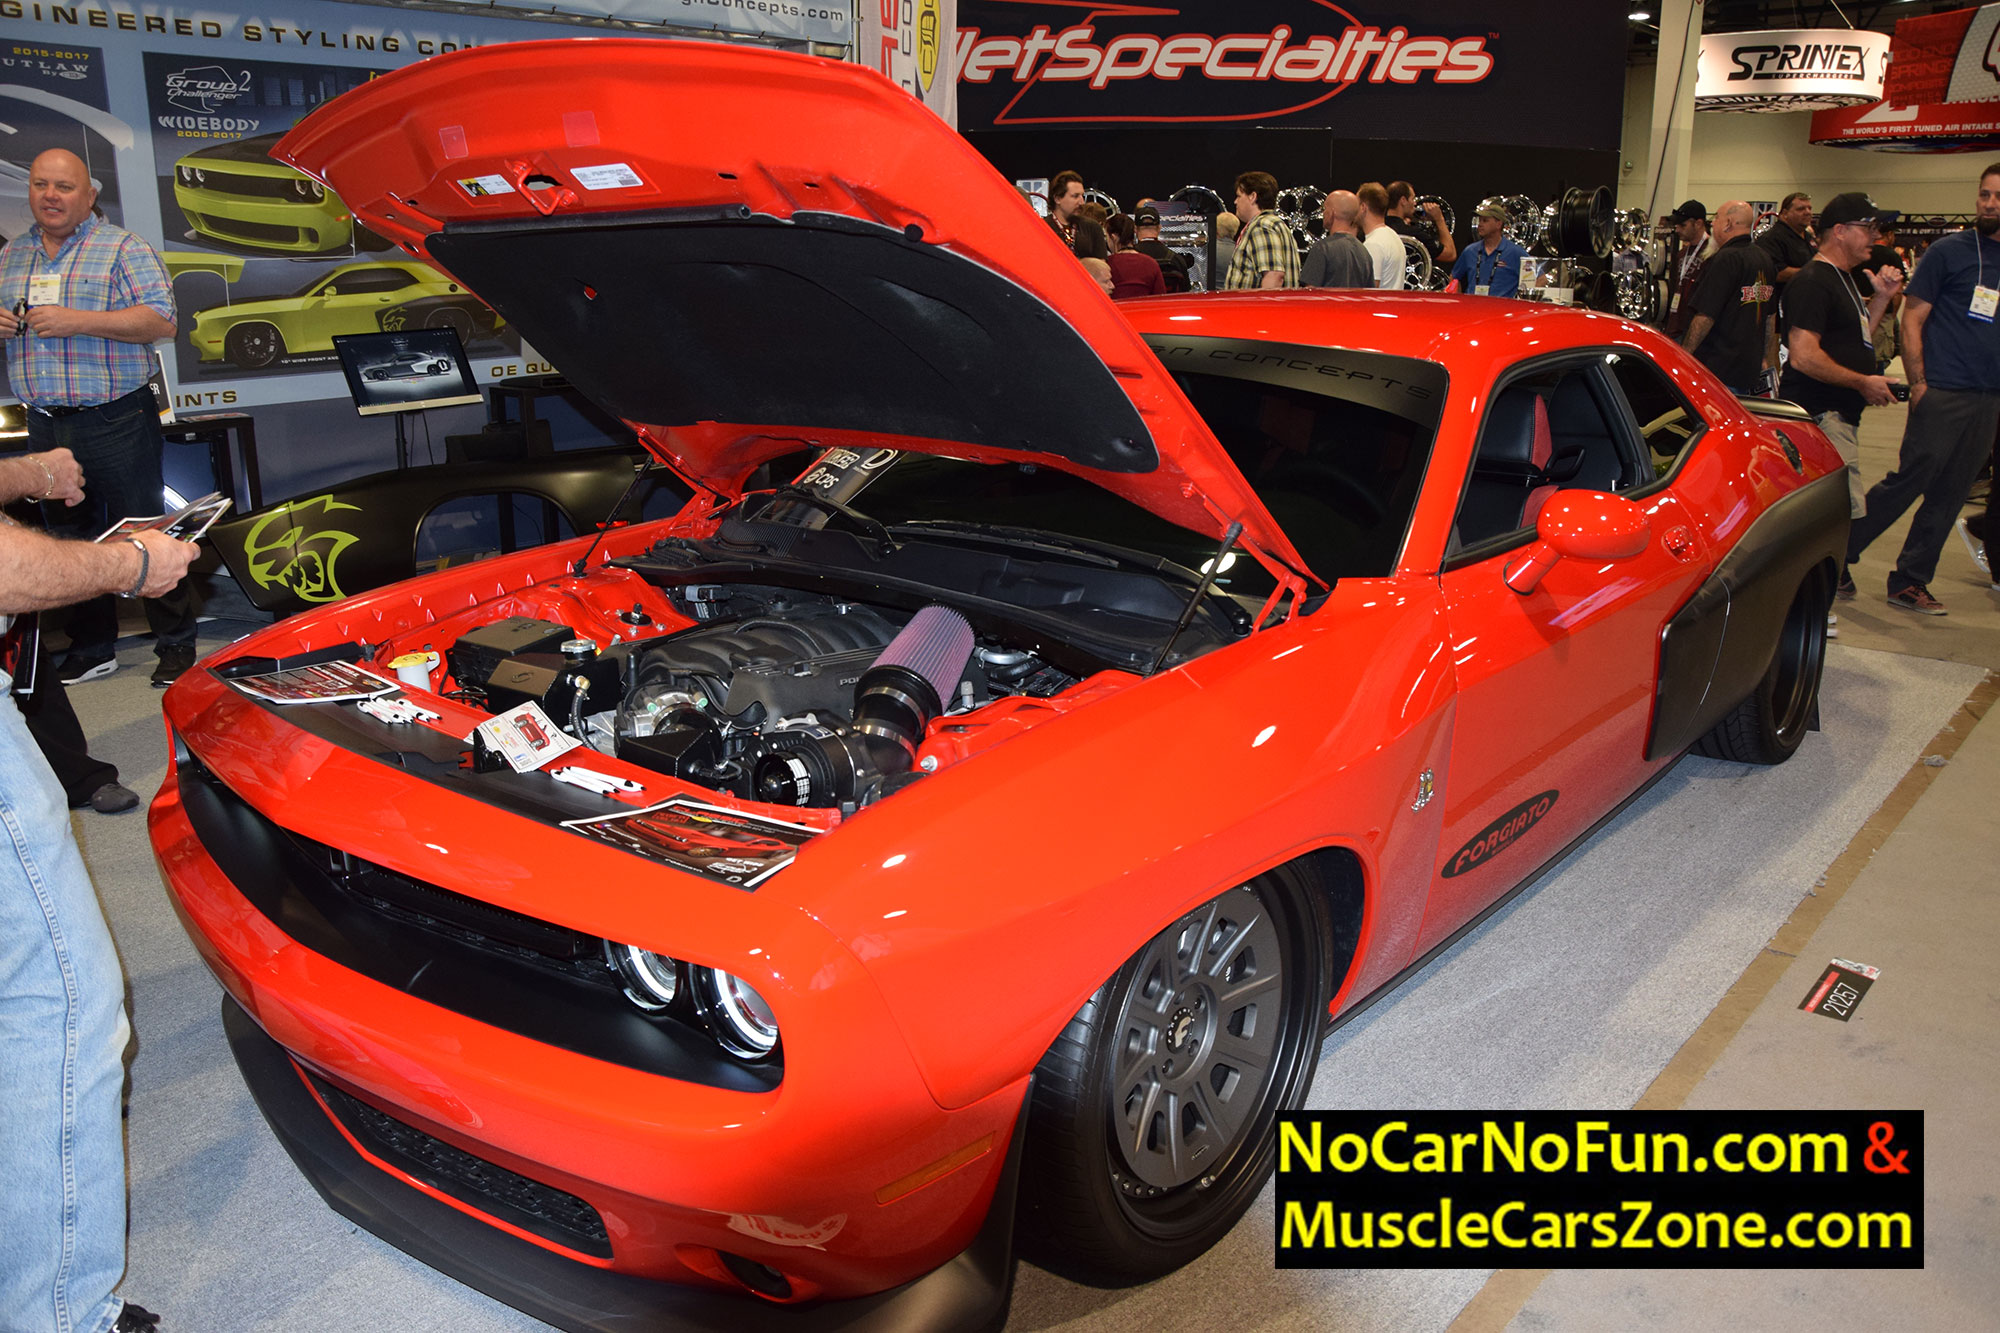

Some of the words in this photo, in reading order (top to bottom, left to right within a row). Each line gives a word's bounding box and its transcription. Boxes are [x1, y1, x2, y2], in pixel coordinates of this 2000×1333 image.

[0, 0, 222, 38] GINEERED
[244, 25, 400, 53] STYLING
[417, 39, 481, 56] CO
[13, 47, 89, 61] 2015-2017
[1727, 44, 1870, 81] SPRINTEX
[43, 69, 57, 77] By
[166, 76, 238, 93] Group
[239, 70, 251, 92] 2
[167, 88, 242, 100] Challenger
[158, 116, 260, 131] WIDEBODY
[1842, 128, 1855, 136] THE
[1856, 126, 1887, 135] WORLD'S
[1888, 125, 1912, 133] FIRST
[1913, 124, 1942, 132] TUNED
[1961, 122, 1994, 131] INTAKE
[177, 130, 242, 139] 2008-2017
[491, 364, 518, 378] OE
[1209, 348, 1433, 400] CONCEPTS
[175, 390, 238, 408] INTS
[815, 472, 839, 489] CPS
[1453, 797, 1550, 874] FORGIATO
[1823, 982, 1859, 1016] 21257
